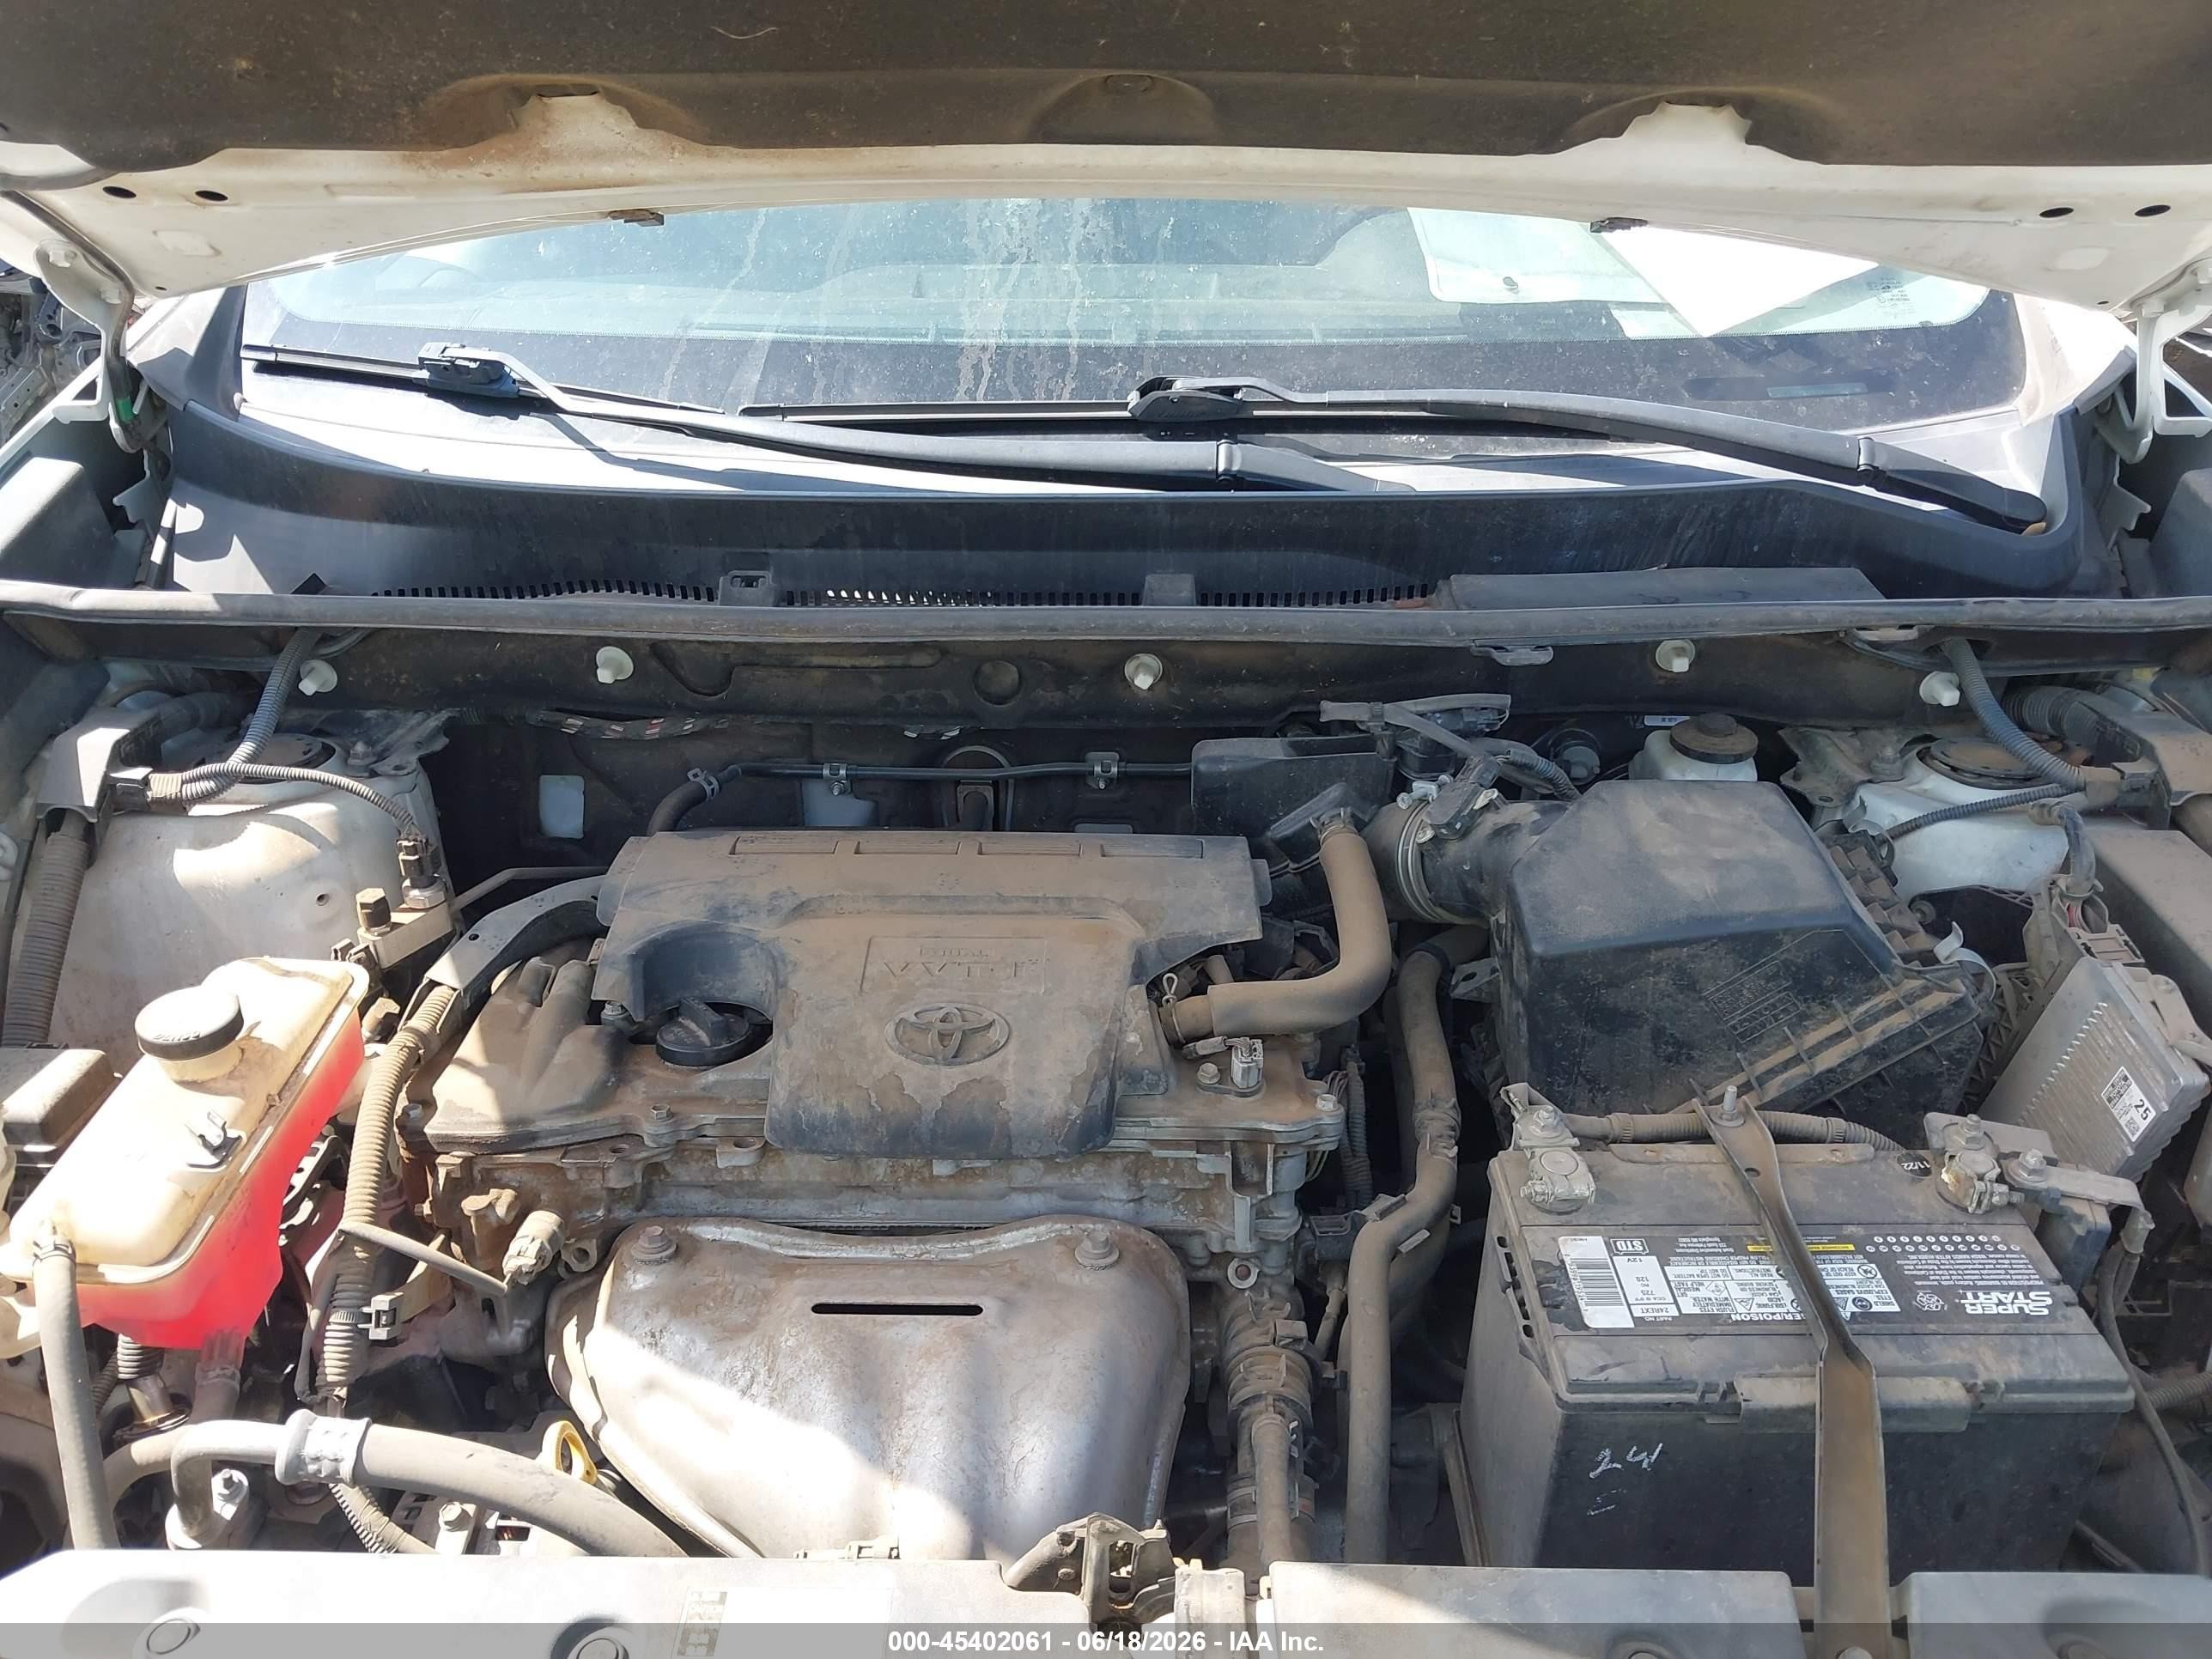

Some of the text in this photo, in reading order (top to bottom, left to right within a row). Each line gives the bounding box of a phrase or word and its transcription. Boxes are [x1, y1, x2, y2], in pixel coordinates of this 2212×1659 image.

[2135, 1098, 2151, 1121] 25
[1901, 1161, 1930, 1170] 11/22
[1616, 1241, 1644, 1251] STD
[1960, 1291, 2053, 1304] START
[1965, 1304, 2050, 1315] SUPER
